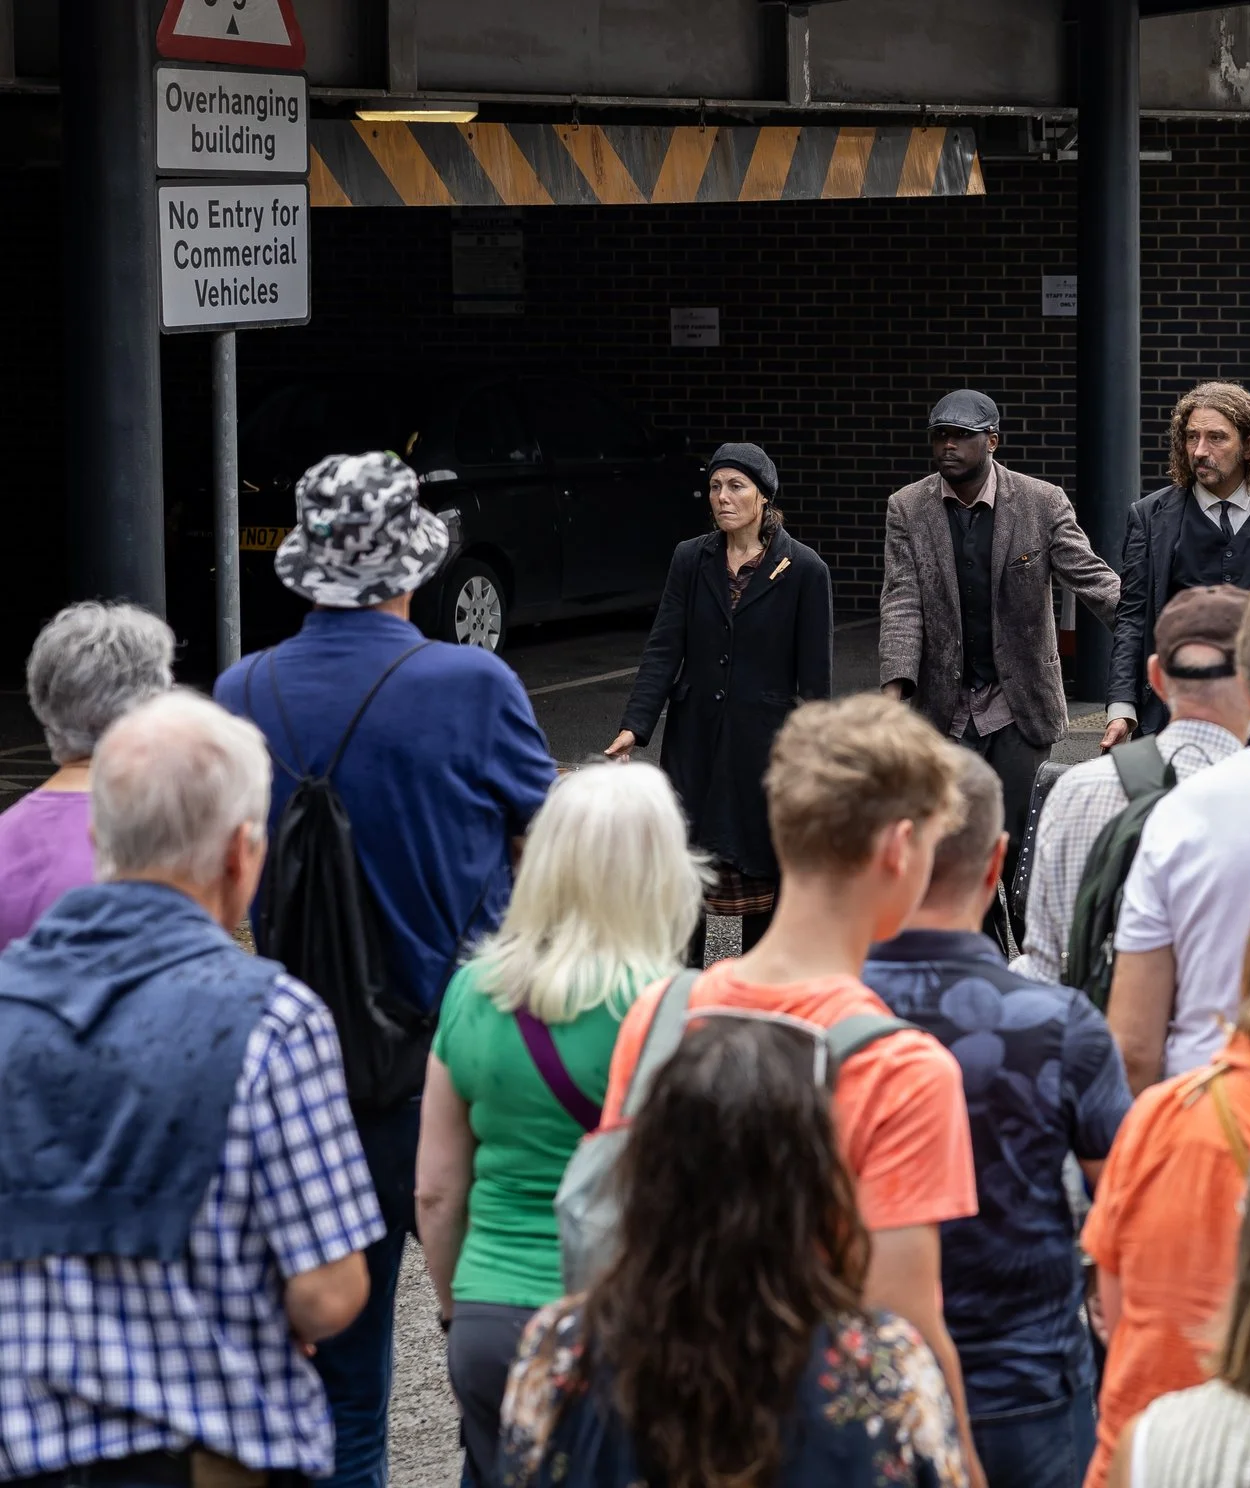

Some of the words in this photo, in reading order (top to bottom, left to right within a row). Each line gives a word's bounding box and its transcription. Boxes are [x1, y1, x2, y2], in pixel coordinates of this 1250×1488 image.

[166, 82, 298, 123] Overhanging
[191, 124, 275, 161] building
[169, 201, 199, 230] No
[208, 199, 264, 233] Entry
[271, 198, 299, 226] for
[173, 236, 297, 270] Commercial
[194, 276, 279, 308] Vehicles
